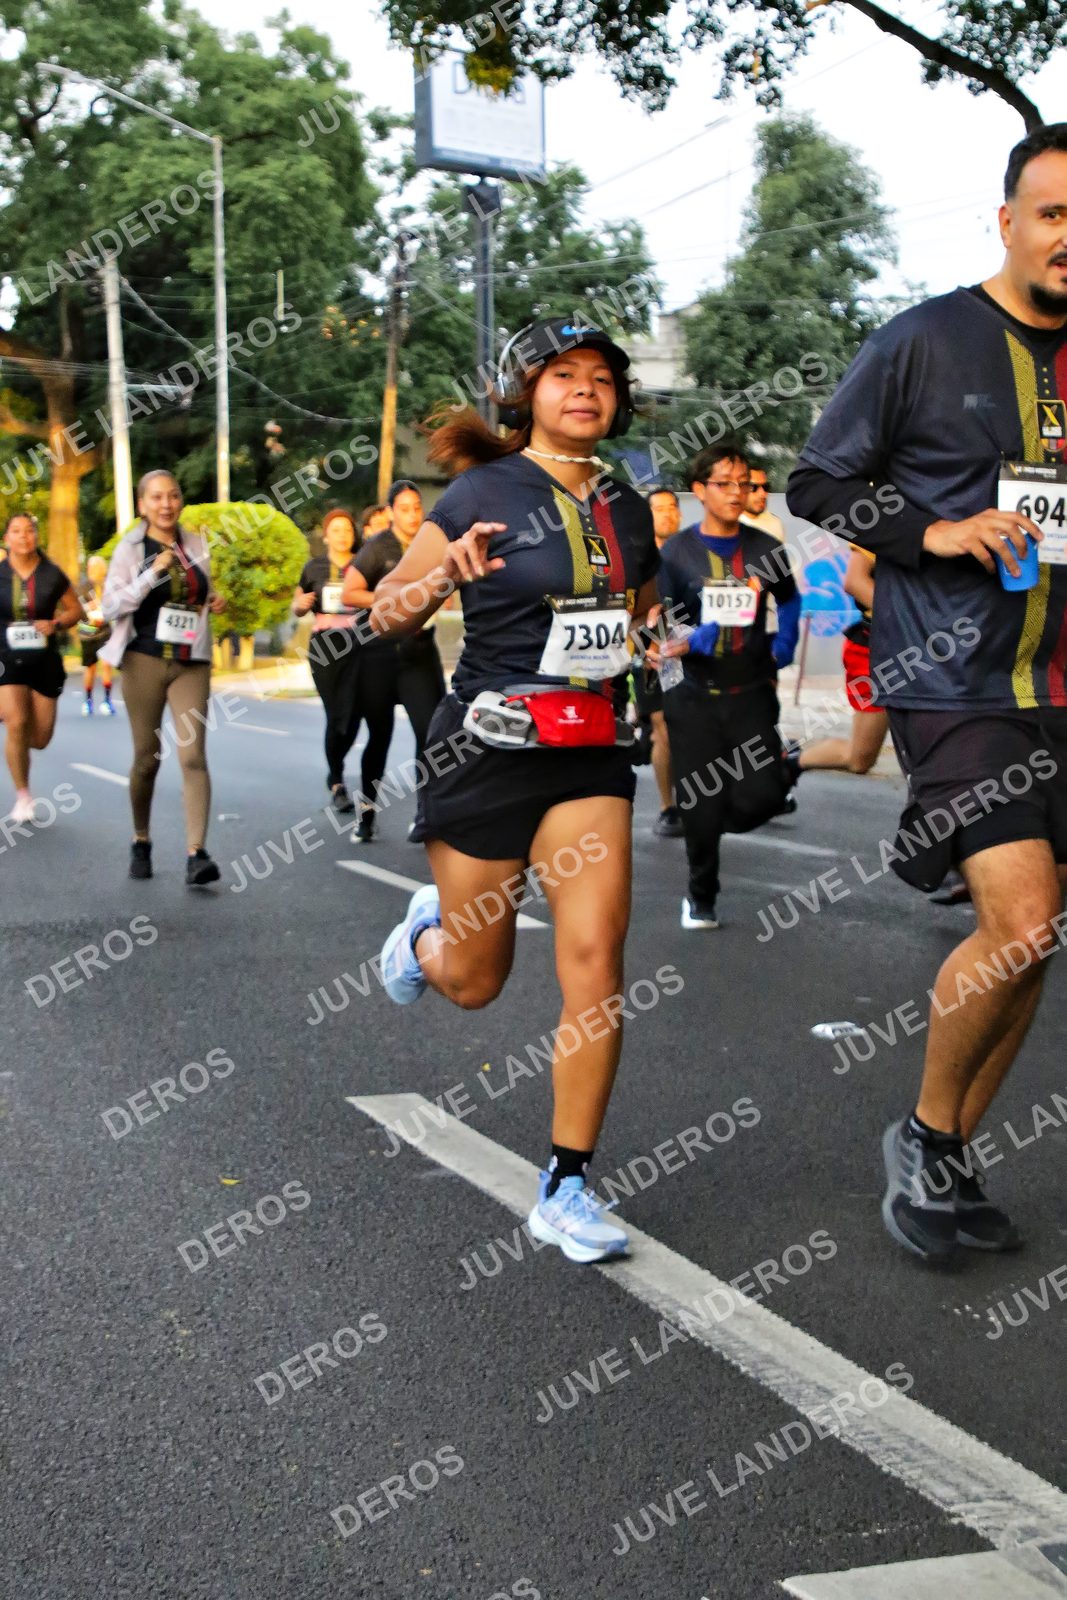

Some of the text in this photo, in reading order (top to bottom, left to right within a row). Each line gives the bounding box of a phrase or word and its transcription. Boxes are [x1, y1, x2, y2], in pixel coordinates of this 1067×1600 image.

[707, 593, 753, 608] 10157
[165, 613, 194, 629] 4321
[563, 621, 626, 651] 7304
